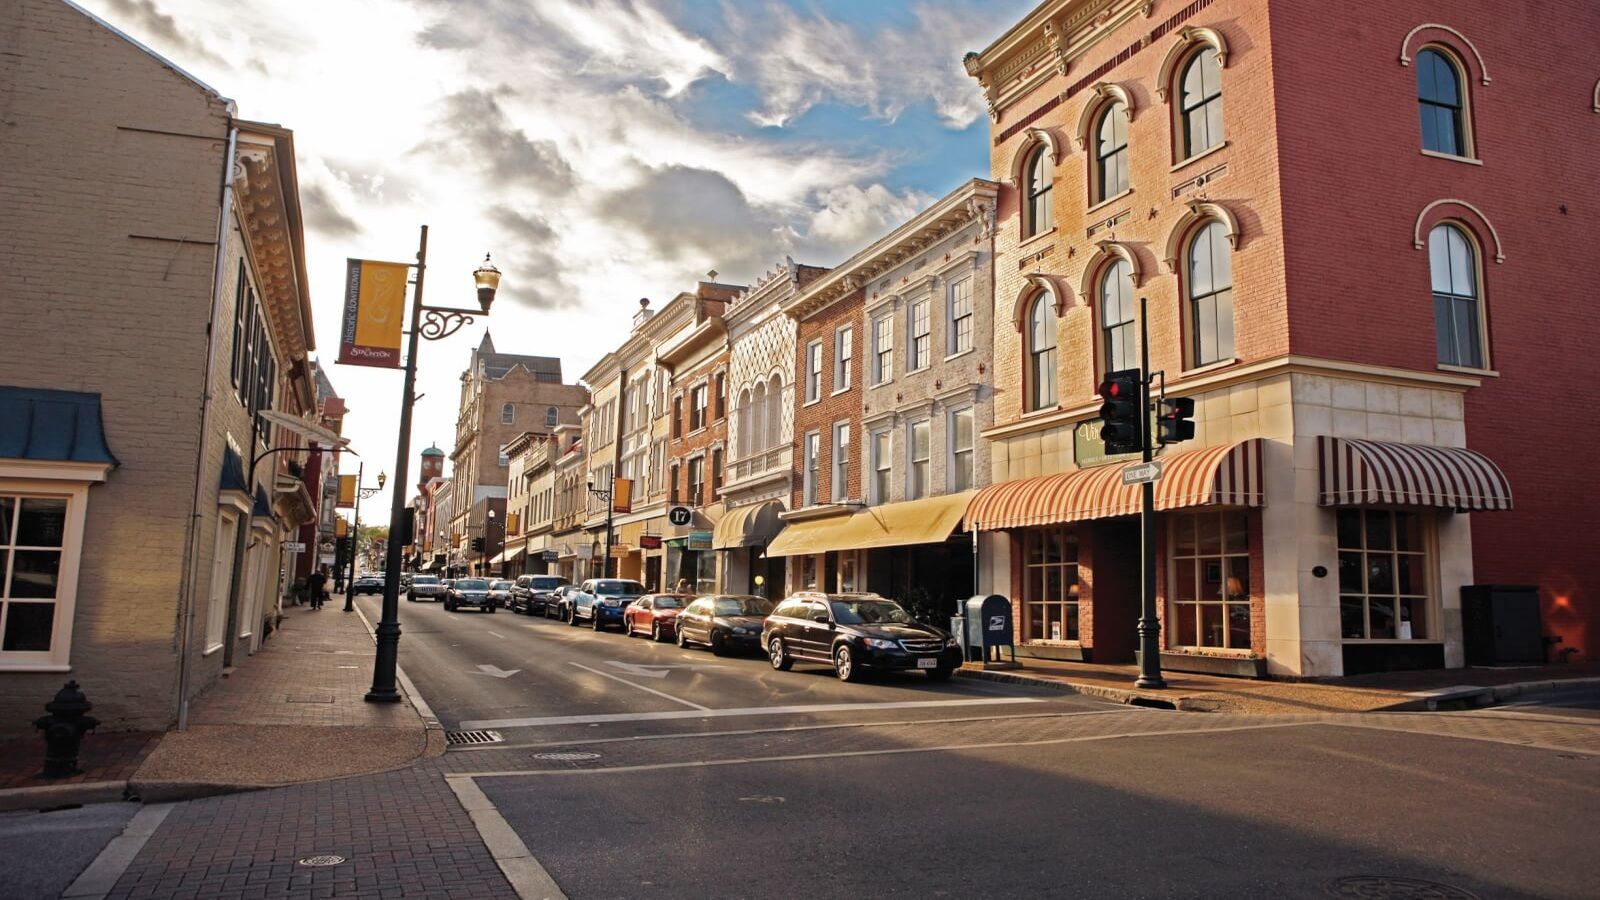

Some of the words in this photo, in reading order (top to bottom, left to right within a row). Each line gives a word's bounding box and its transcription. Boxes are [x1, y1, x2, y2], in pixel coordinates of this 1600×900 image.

[1126, 471, 1137, 480] ONE
[1138, 469, 1150, 478] WAY
[674, 511, 688, 522] 17
